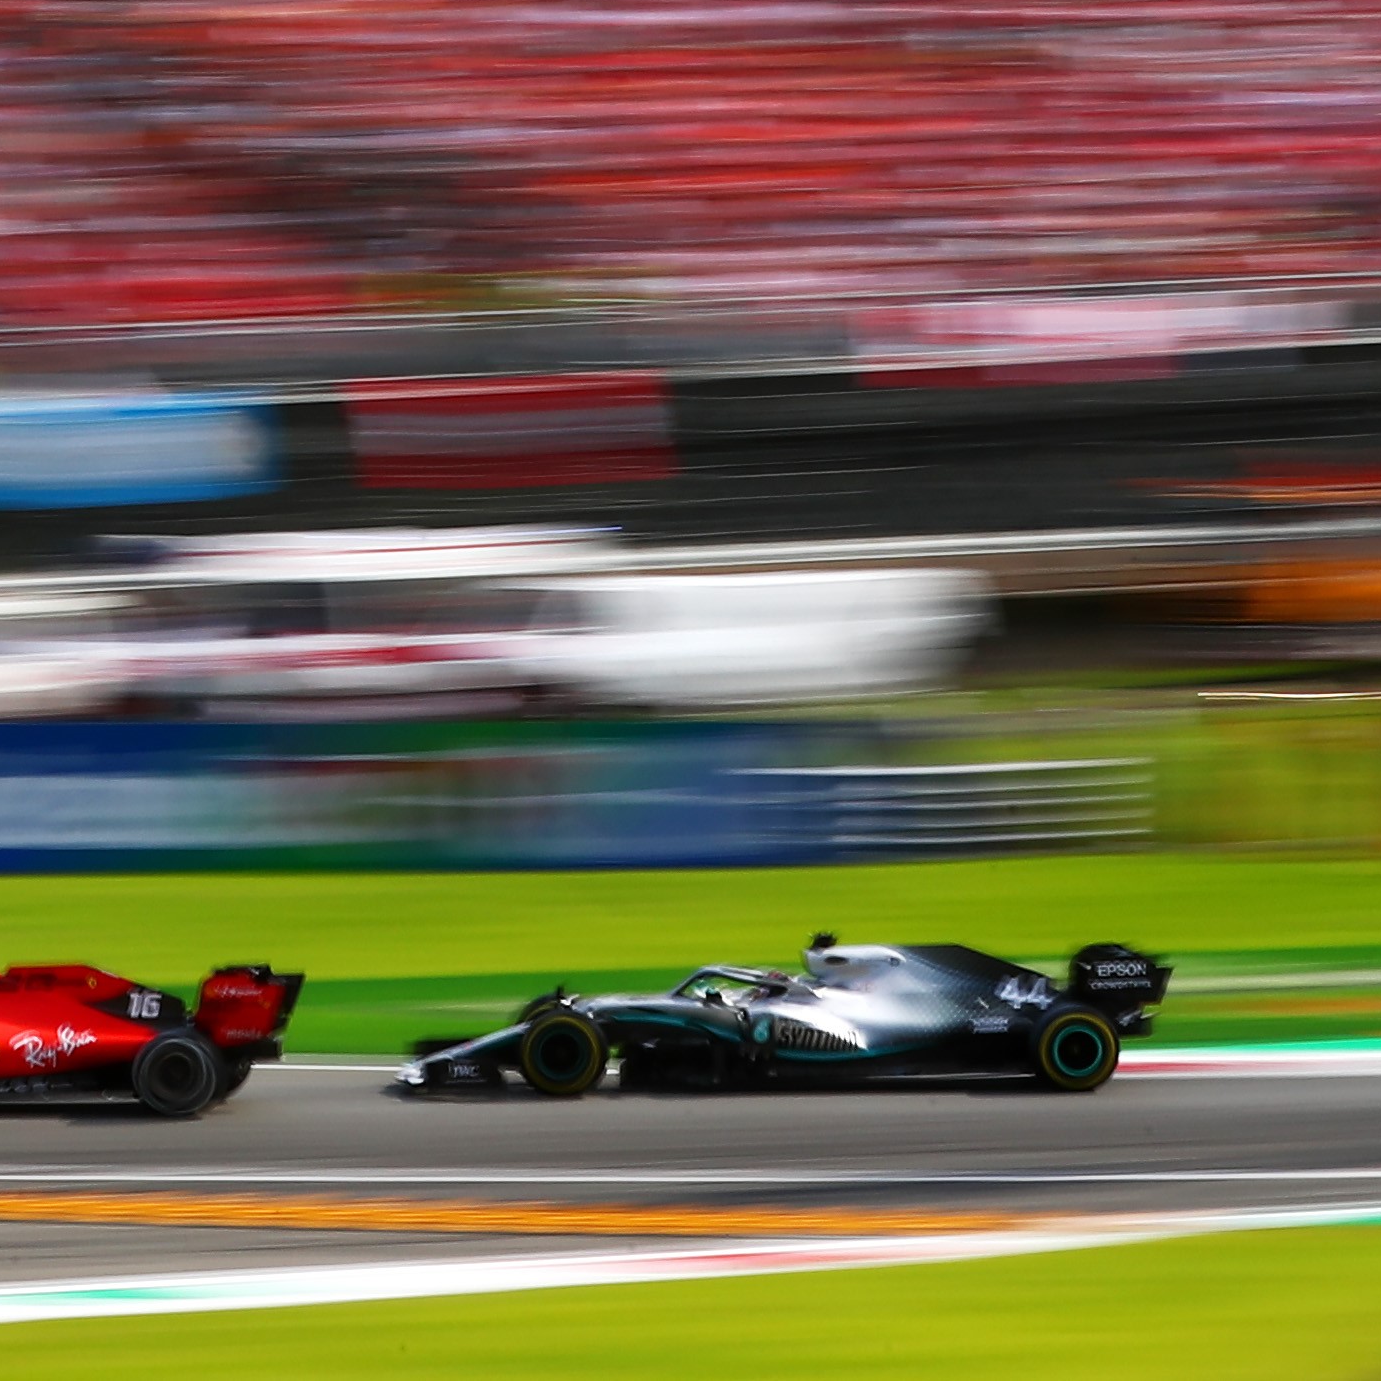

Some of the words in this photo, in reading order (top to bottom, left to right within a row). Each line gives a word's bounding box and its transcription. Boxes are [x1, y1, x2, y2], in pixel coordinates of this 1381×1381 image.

[1097, 962, 1147, 977] EPSON
[129, 992, 163, 1019] 16
[999, 977, 1052, 1010] 44
[9, 1022, 98, 1068] Ray-Ban
